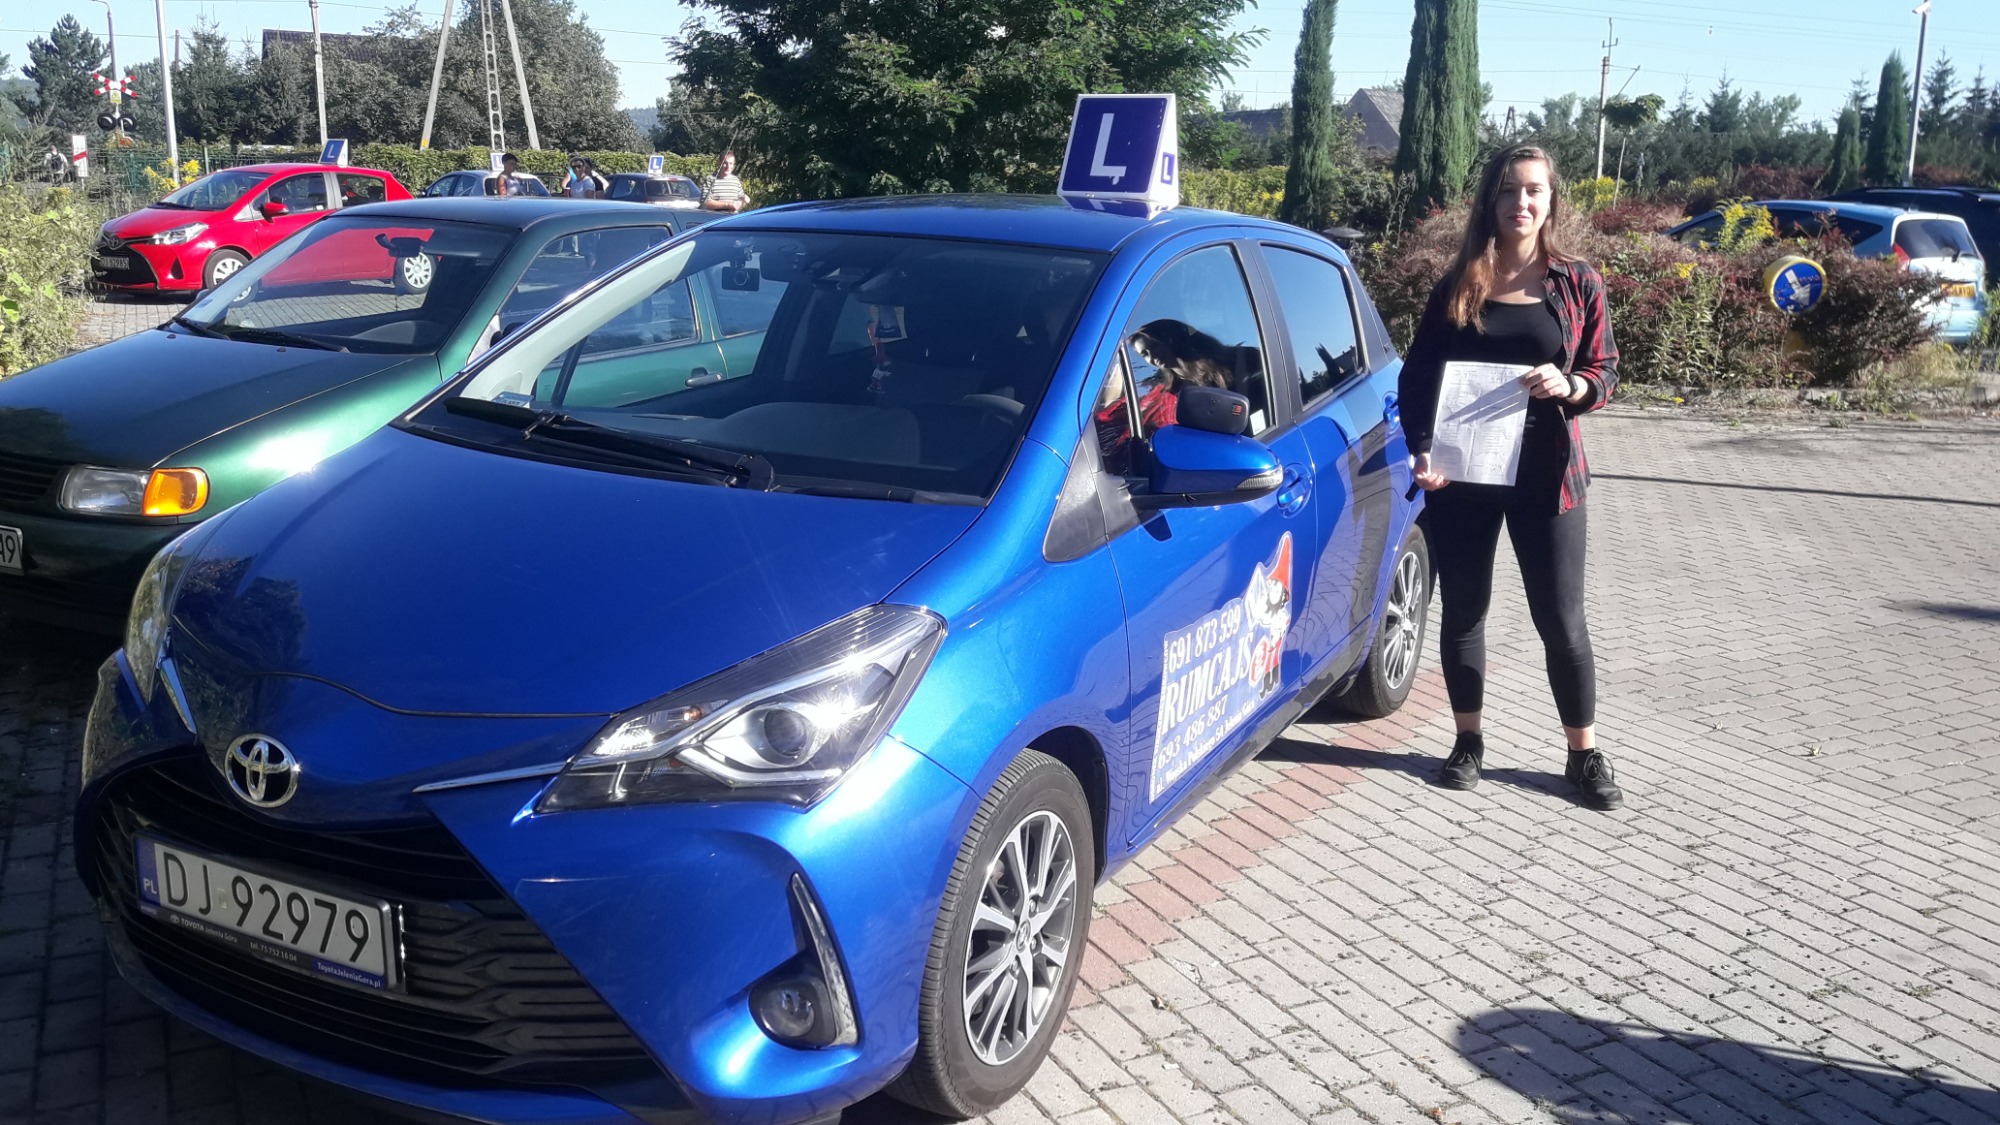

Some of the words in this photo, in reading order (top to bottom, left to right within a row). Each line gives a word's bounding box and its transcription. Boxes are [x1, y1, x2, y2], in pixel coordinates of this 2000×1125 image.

[327, 144, 335, 158] L
[1090, 113, 1127, 176] L
[653, 158, 660, 169] L
[1163, 156, 1171, 181] L
[1168, 631, 1191, 674] 691
[1194, 619, 1218, 658] 873
[1219, 604, 1241, 643] 599
[1162, 631, 1254, 735] RUMCAJS
[1158, 735, 1182, 769] 693
[1183, 712, 1206, 746] 486
[1206, 694, 1228, 729] 887
[143, 878, 158, 895] PL
[163, 851, 212, 916] DJ
[230, 875, 370, 963] 92979
[181, 917, 205, 931] TOYOTA
[317, 962, 382, 989] ToyotaJeleniaGora.pl
